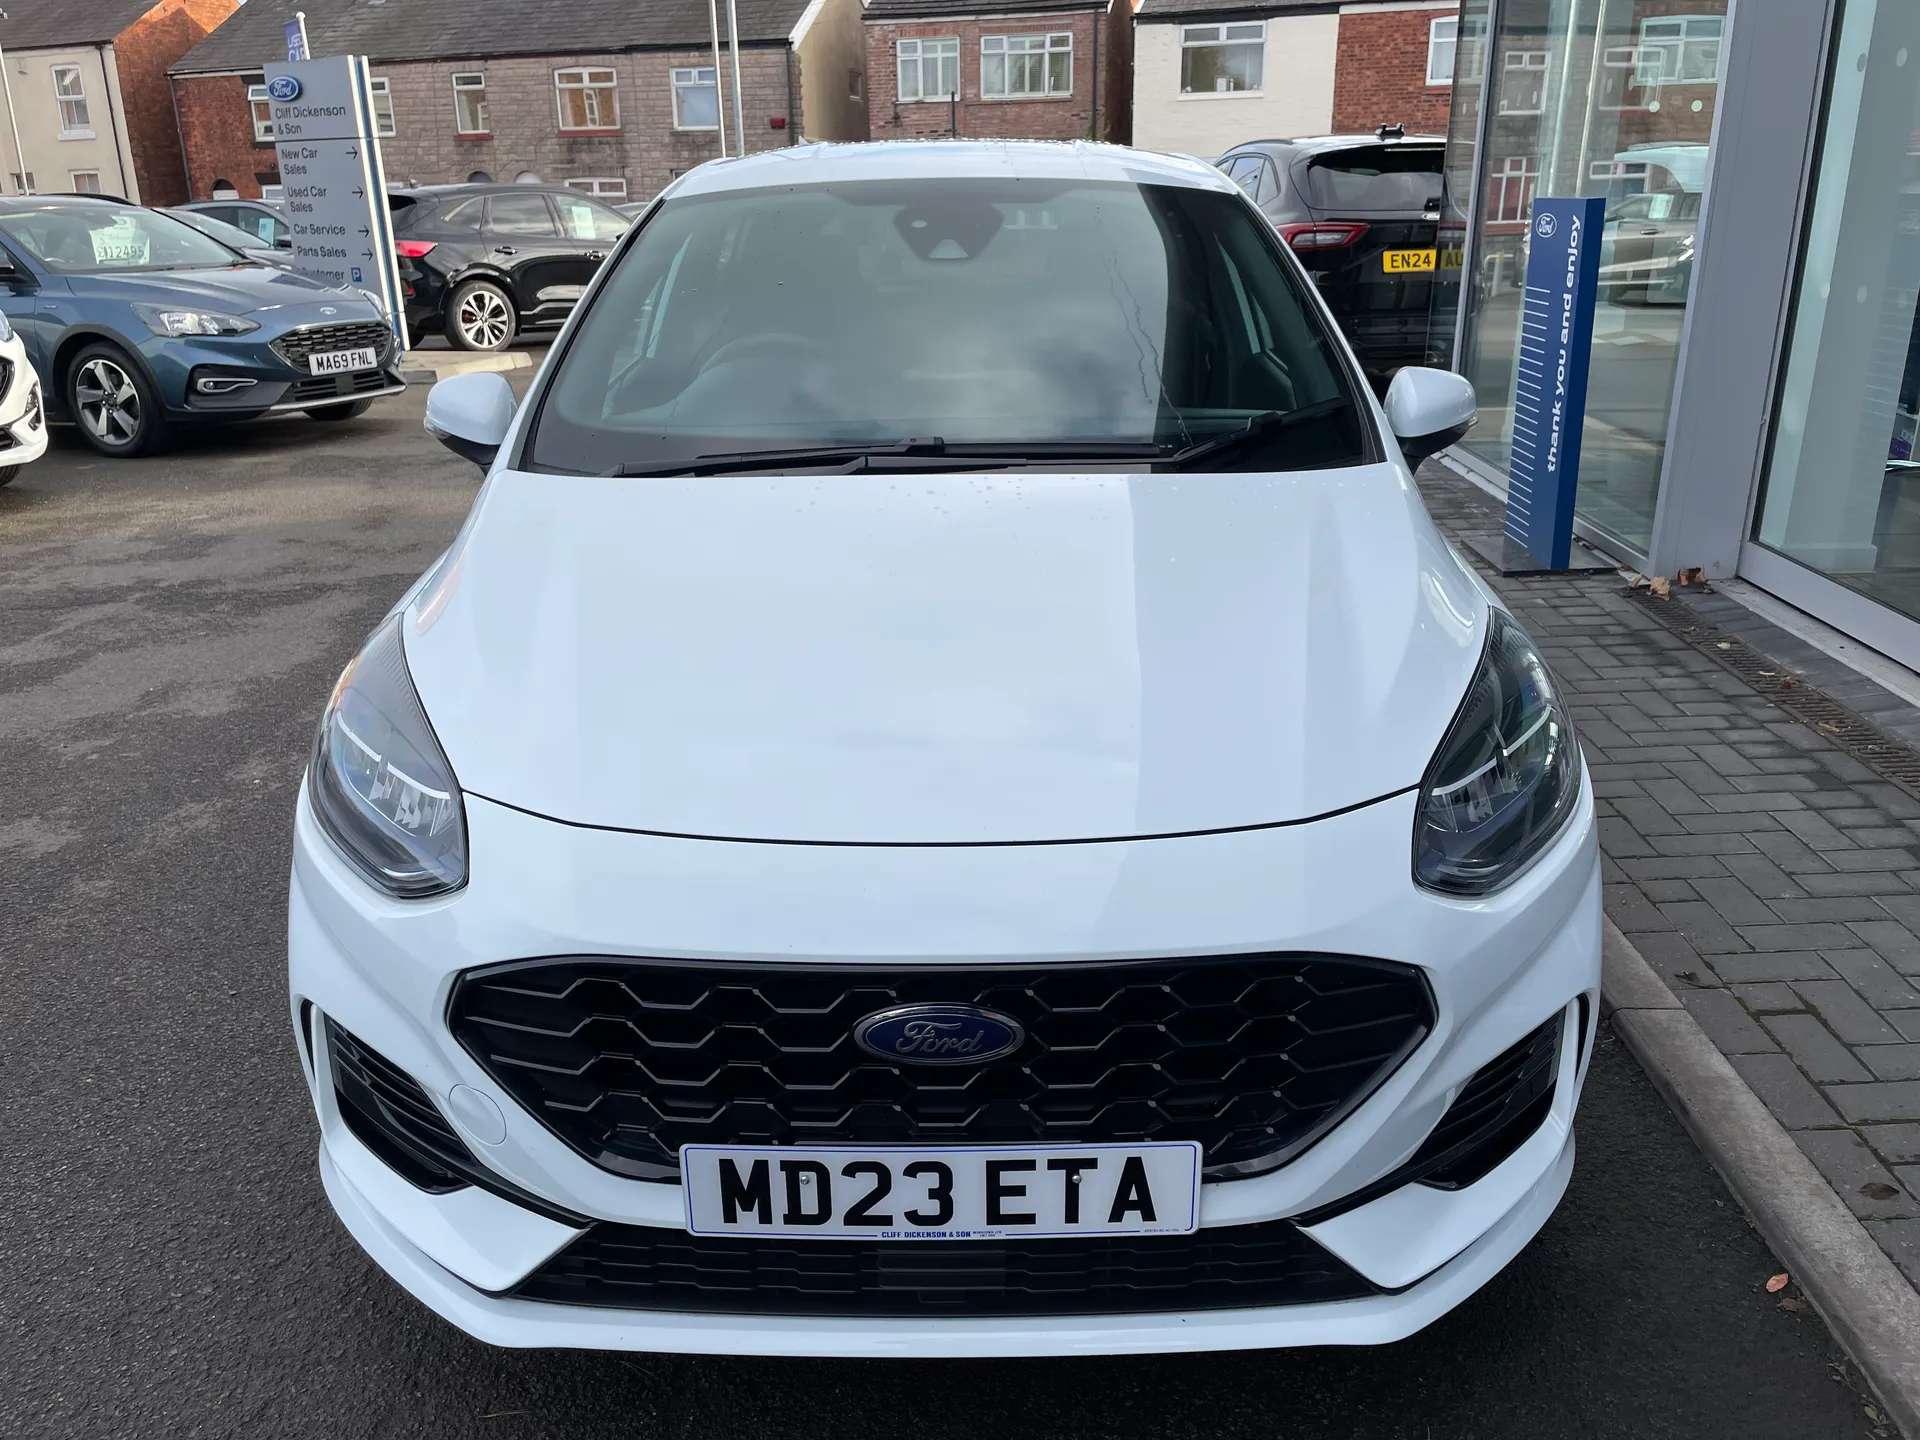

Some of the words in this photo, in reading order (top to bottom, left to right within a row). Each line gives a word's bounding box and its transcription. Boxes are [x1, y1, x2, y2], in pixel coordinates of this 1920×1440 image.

[275, 106, 291, 119] Cliff
[293, 105, 346, 118] Dickenson
[278, 125, 284, 135] &
[285, 124, 302, 134] Son
[281, 149, 299, 159] New
[301, 147, 318, 159] Car
[284, 164, 307, 175] Sales
[287, 186, 309, 197] Used
[310, 186, 327, 197] Car
[290, 202, 313, 212] Sales
[293, 224, 308, 234] Car
[309, 224, 346, 235] Service
[297, 246, 319, 257] Parts
[320, 246, 347, 257] Sales
[1566, 215, 1580, 289] enjoy
[1391, 253, 1432, 269] EN24
[1560, 293, 1573, 344] and
[316, 354, 348, 371] MA69
[350, 351, 372, 367] FNL
[1555, 349, 1566, 396] you
[1548, 401, 1561, 472] thank
[896, 1021, 985, 1052] Ford
[718, 1158, 953, 1227] MD23
[985, 1156, 1157, 1225] ETA
